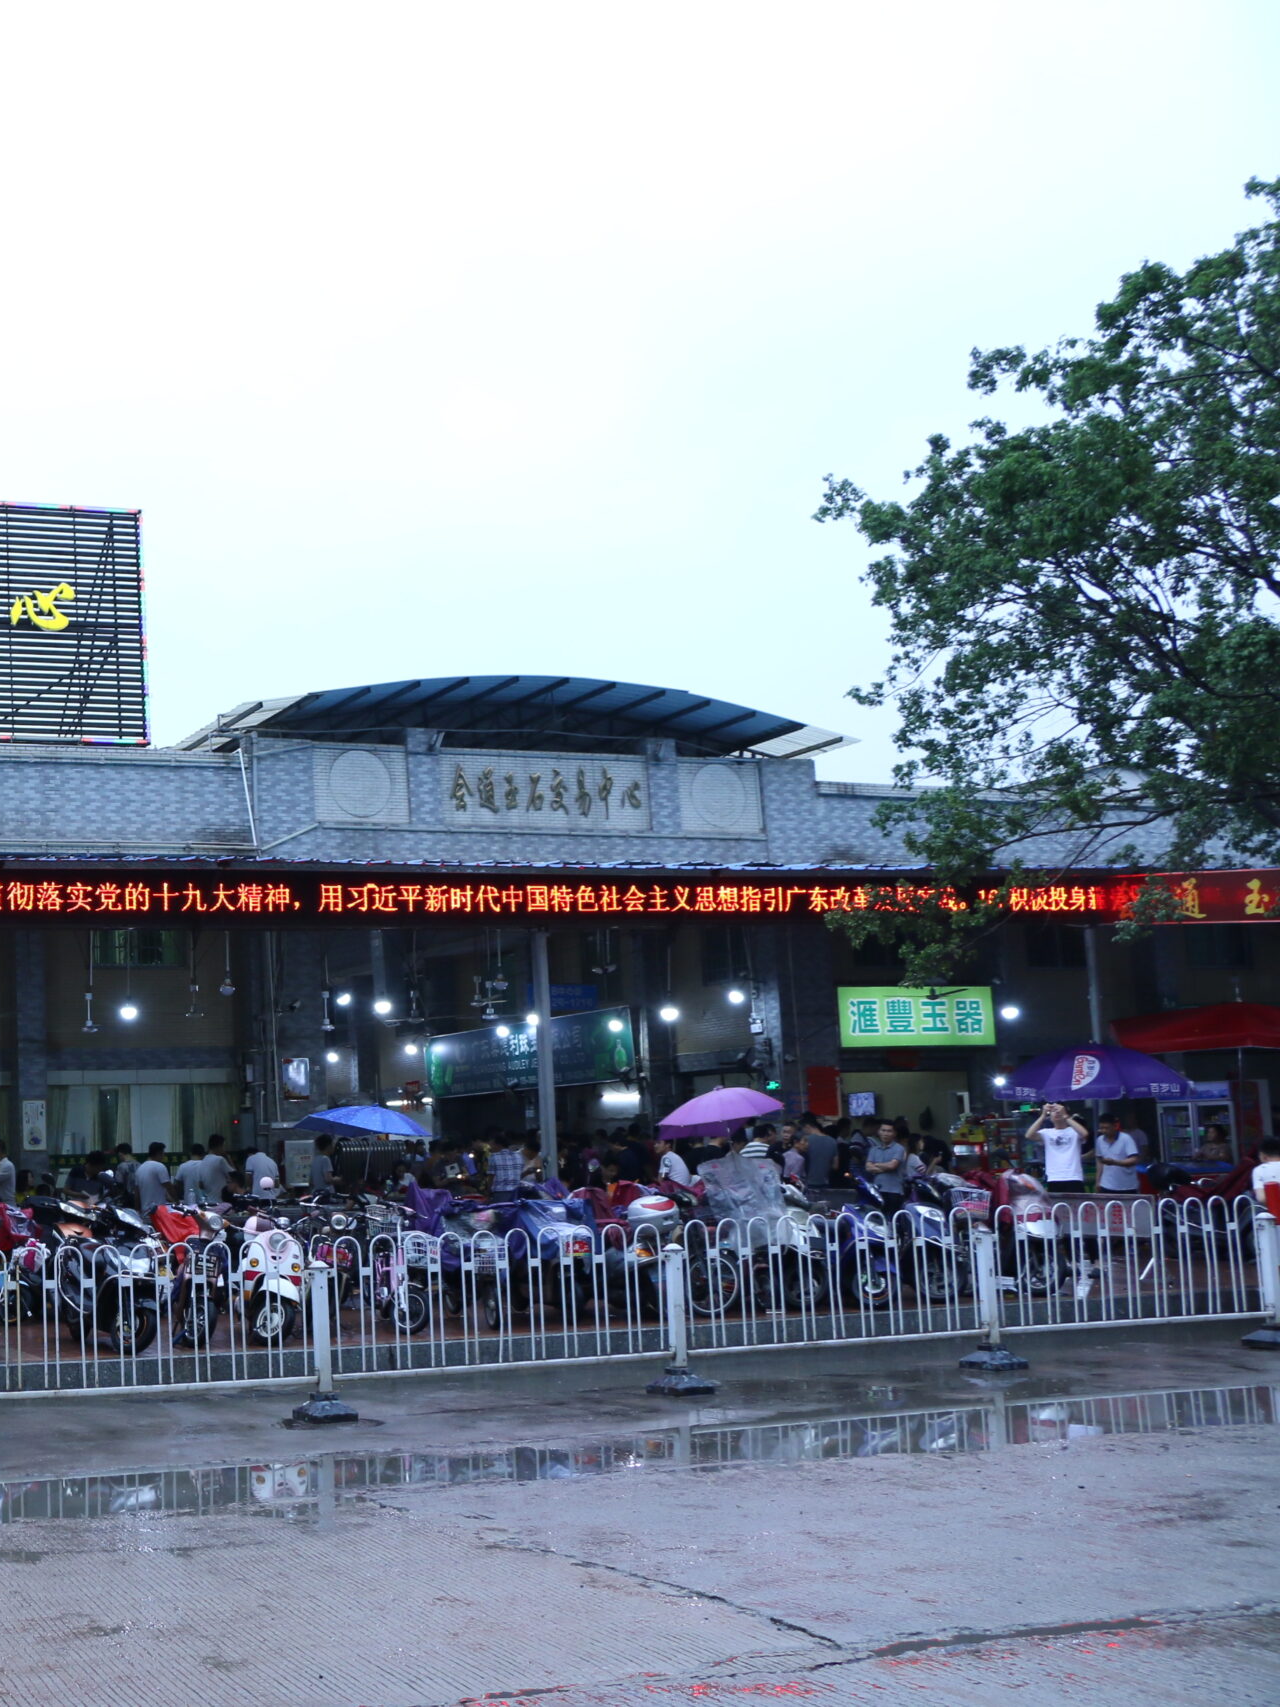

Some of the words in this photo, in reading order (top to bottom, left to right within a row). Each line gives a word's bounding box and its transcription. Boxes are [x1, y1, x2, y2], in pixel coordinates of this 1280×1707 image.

[449, 763, 641, 819] 会通玉石交易中心
[1149, 1083, 1181, 1093] 百岁山
